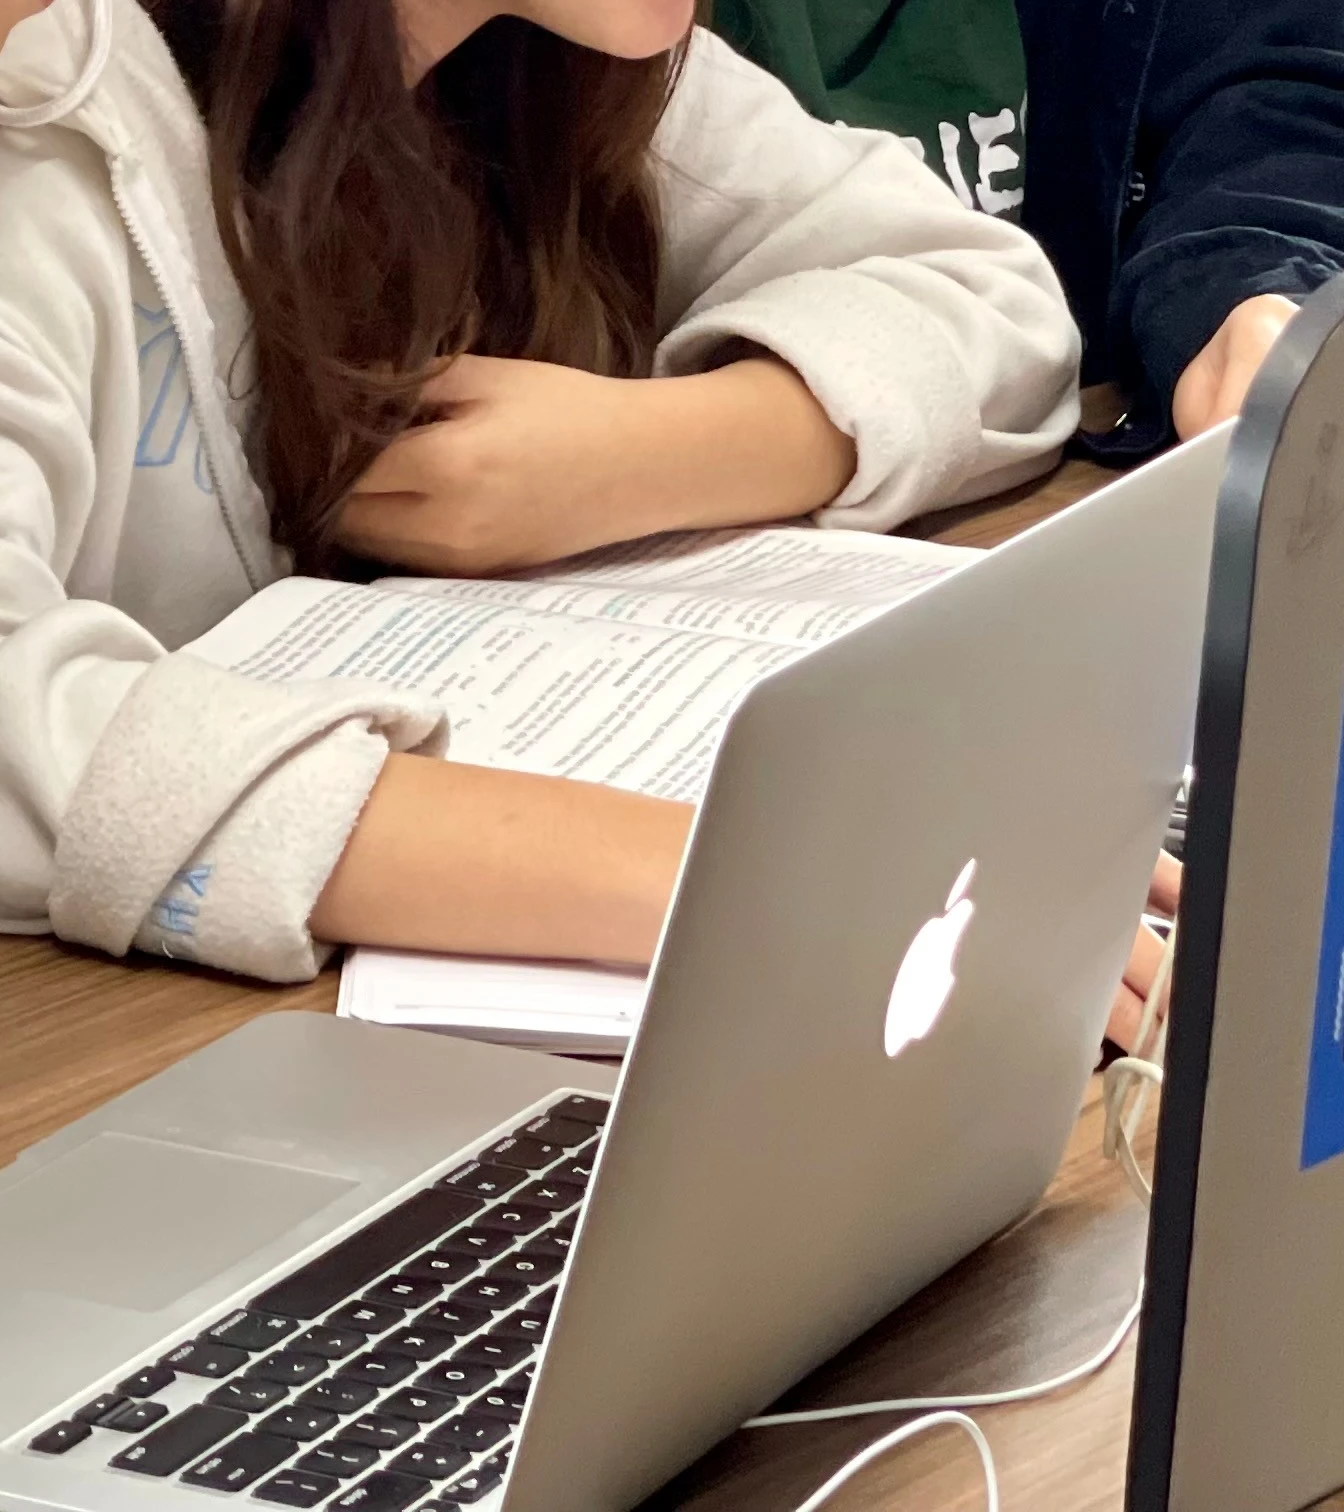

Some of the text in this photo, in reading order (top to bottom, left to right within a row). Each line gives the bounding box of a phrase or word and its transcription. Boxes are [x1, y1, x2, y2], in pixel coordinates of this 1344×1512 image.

[537, 1188, 558, 1198] X
[502, 1212, 521, 1221] C
[431, 1260, 449, 1269] B
[516, 1261, 534, 1271] G
[392, 1285, 413, 1294] N
[478, 1286, 500, 1296] H
[353, 1309, 376, 1320] M
[520, 1319, 541, 1329] U
[403, 1337, 425, 1346] K
[445, 1370, 465, 1380] O
[410, 1397, 427, 1407] P
